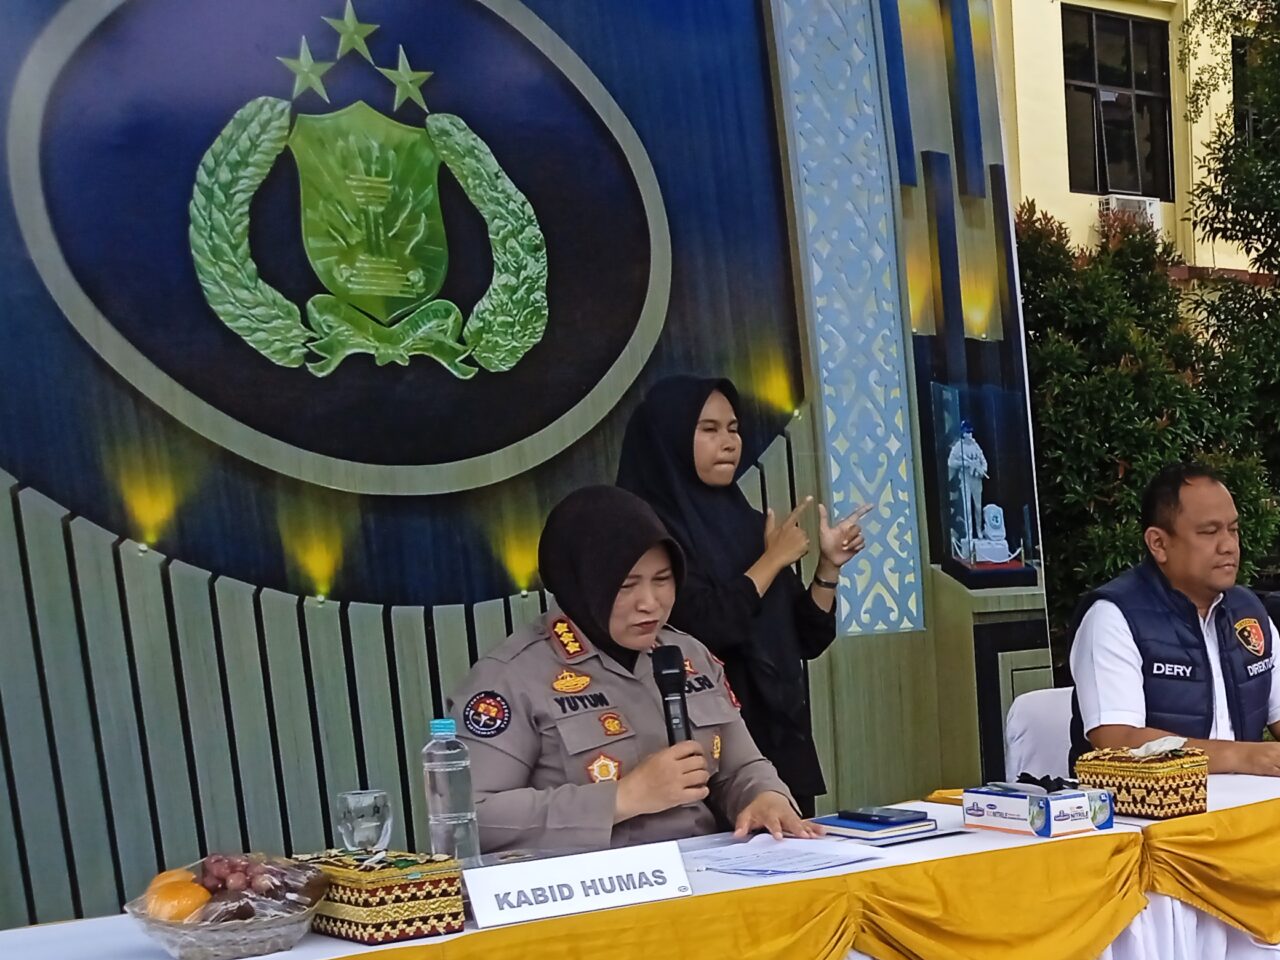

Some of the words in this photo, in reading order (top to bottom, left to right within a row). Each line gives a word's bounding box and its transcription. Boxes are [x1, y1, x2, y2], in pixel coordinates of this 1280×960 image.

[1153, 663, 1193, 677] DERY
[685, 674, 714, 692] OLRI
[553, 692, 609, 714] YUYUN
[494, 883, 574, 911] KABID
[580, 869, 668, 897] HUMAS
